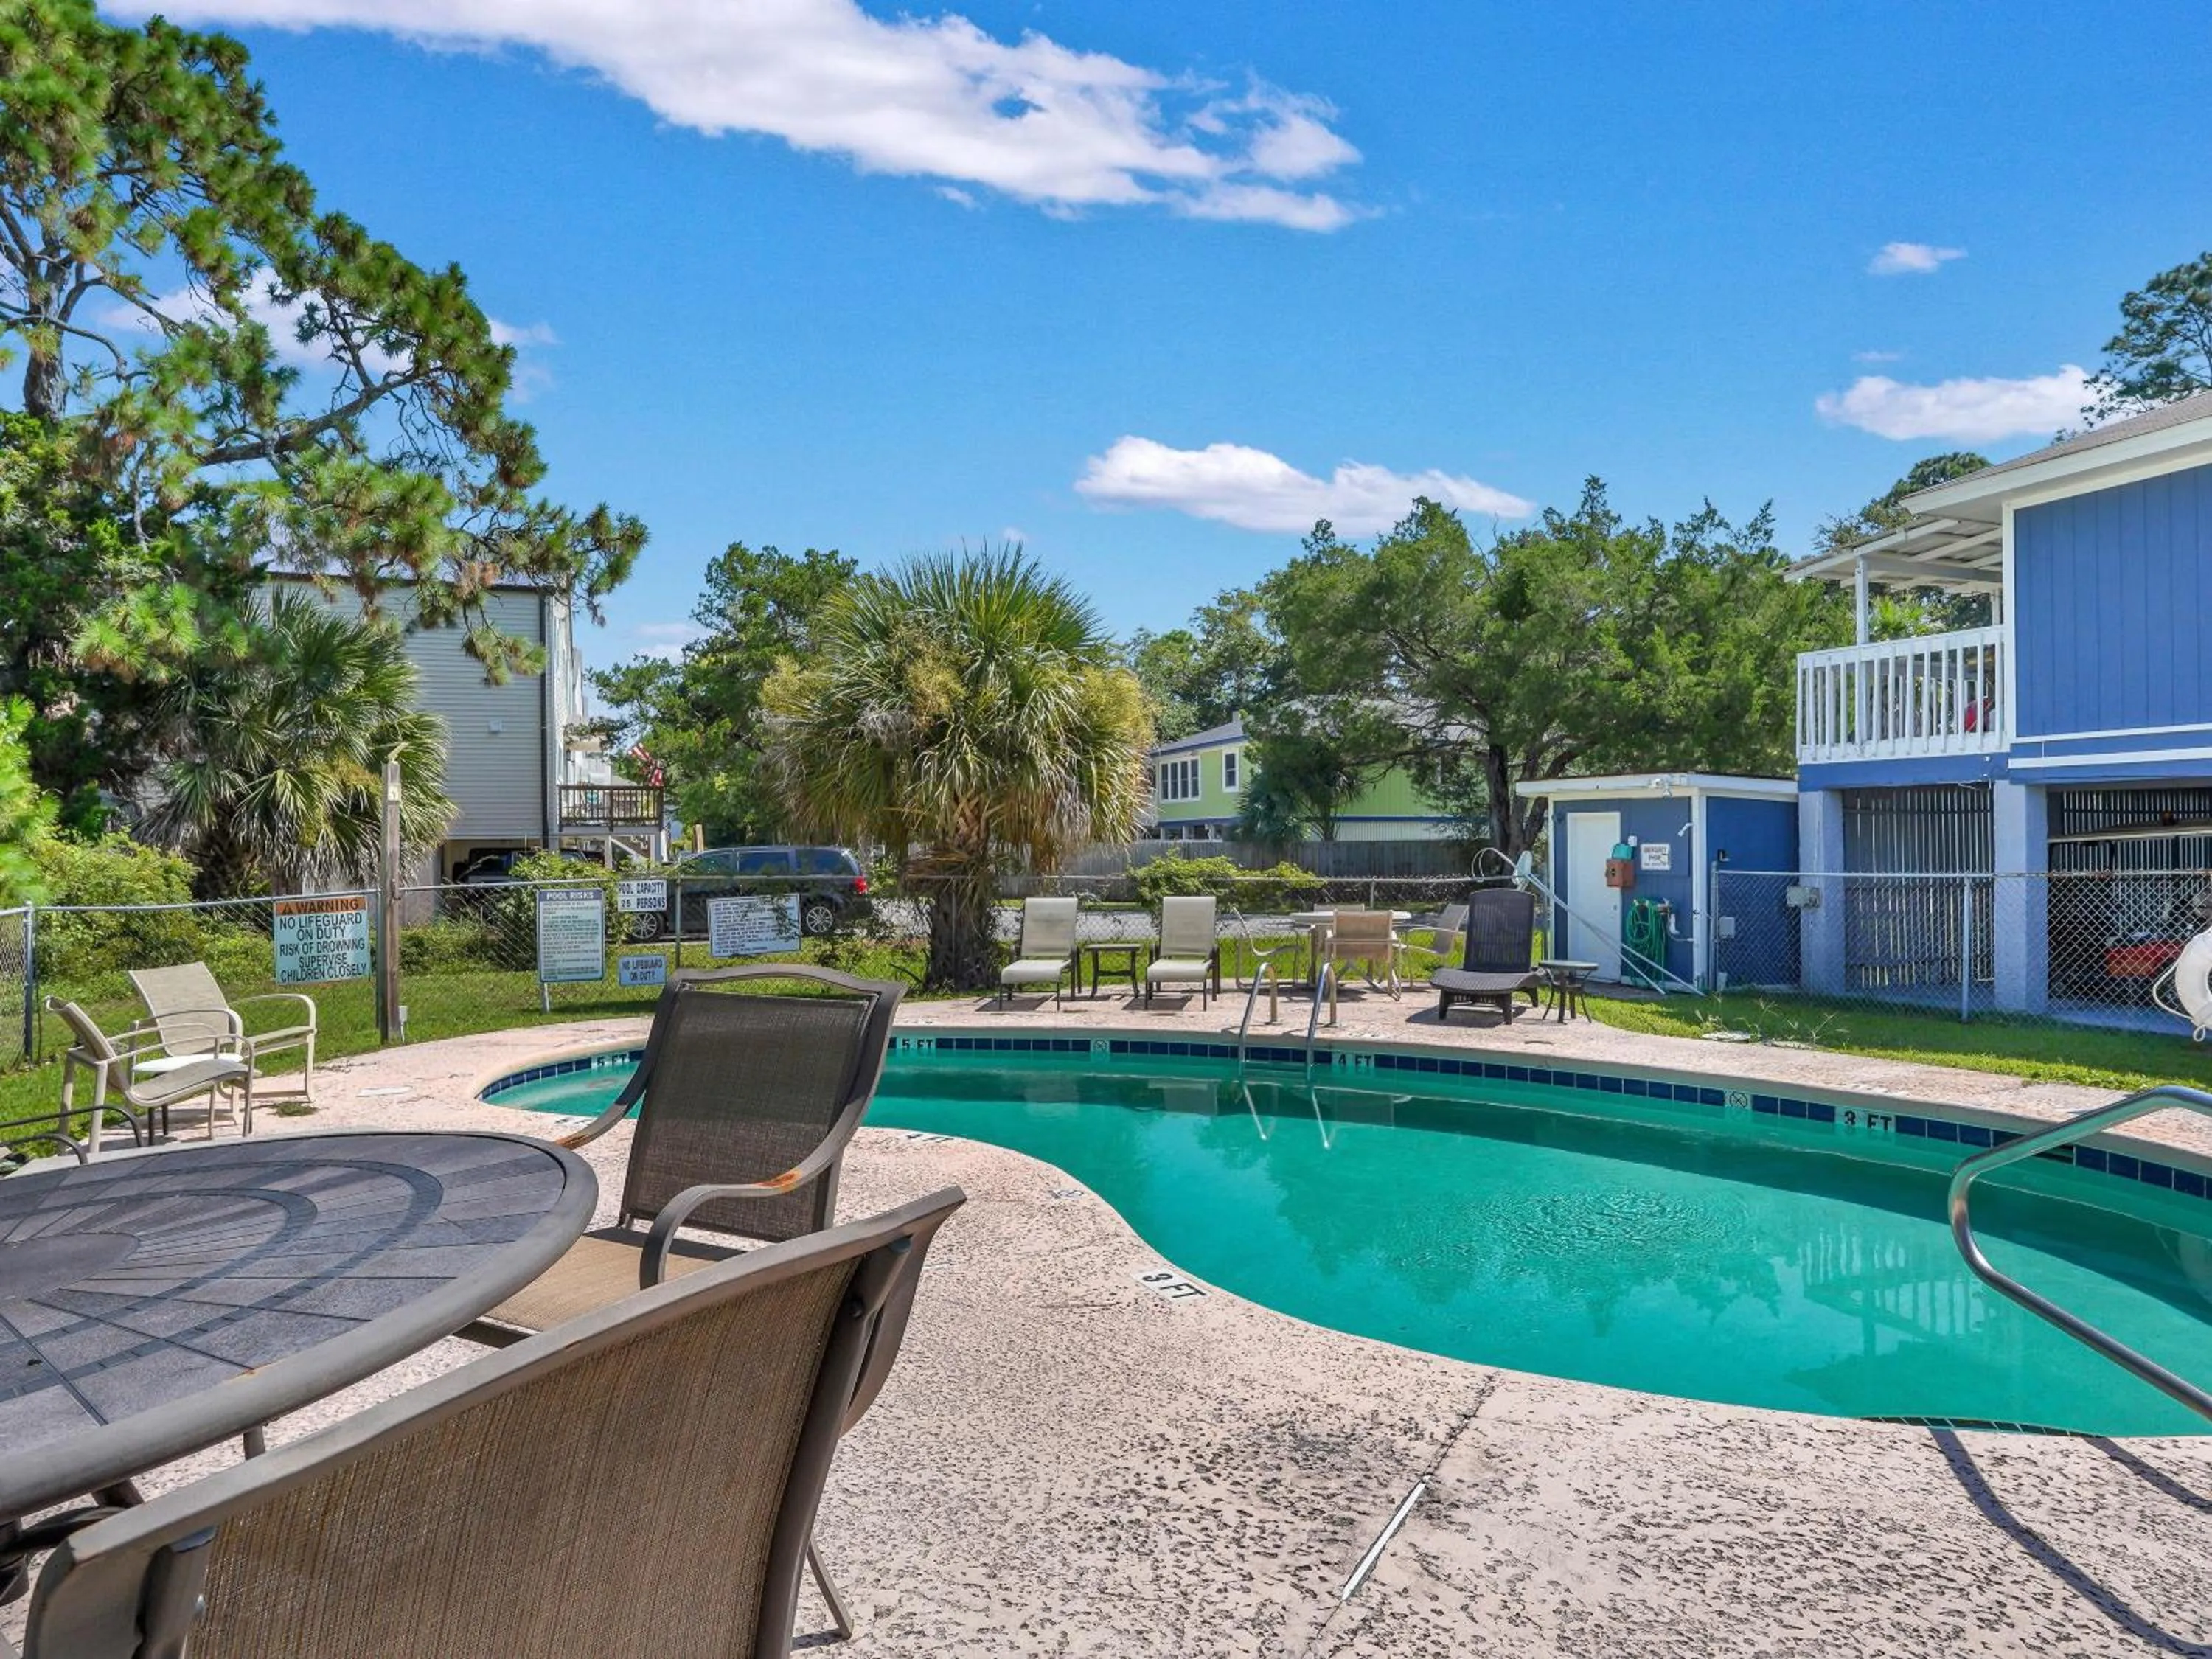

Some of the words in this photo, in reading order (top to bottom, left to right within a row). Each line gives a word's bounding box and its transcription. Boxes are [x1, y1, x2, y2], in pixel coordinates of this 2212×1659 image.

[637, 881, 664, 894] CAPACITY
[546, 891, 567, 900] POOL
[622, 899, 631, 908] 25
[636, 897, 665, 908] PERSONS
[296, 899, 358, 914] WARNING
[279, 917, 296, 930] NO
[299, 913, 362, 928] LIFEGUARD
[296, 928, 313, 941] ON
[316, 926, 346, 939] DUTY
[279, 944, 299, 956] RISK
[302, 942, 316, 954] OF
[317, 938, 365, 953] DROWNING
[299, 953, 347, 968] SUPERVISE
[281, 967, 326, 982] CHILDREN
[327, 963, 366, 978] CLOSELY
[902, 1038, 911, 1049] 5
[917, 1038, 933, 1049] FT
[612, 1054, 627, 1065] FT
[1338, 1054, 1346, 1065] 4
[1355, 1055, 1371, 1067] FT
[1845, 1110, 1856, 1126] 3
[1868, 1114, 1893, 1130] FT
[1160, 1282, 1206, 1298] FT
